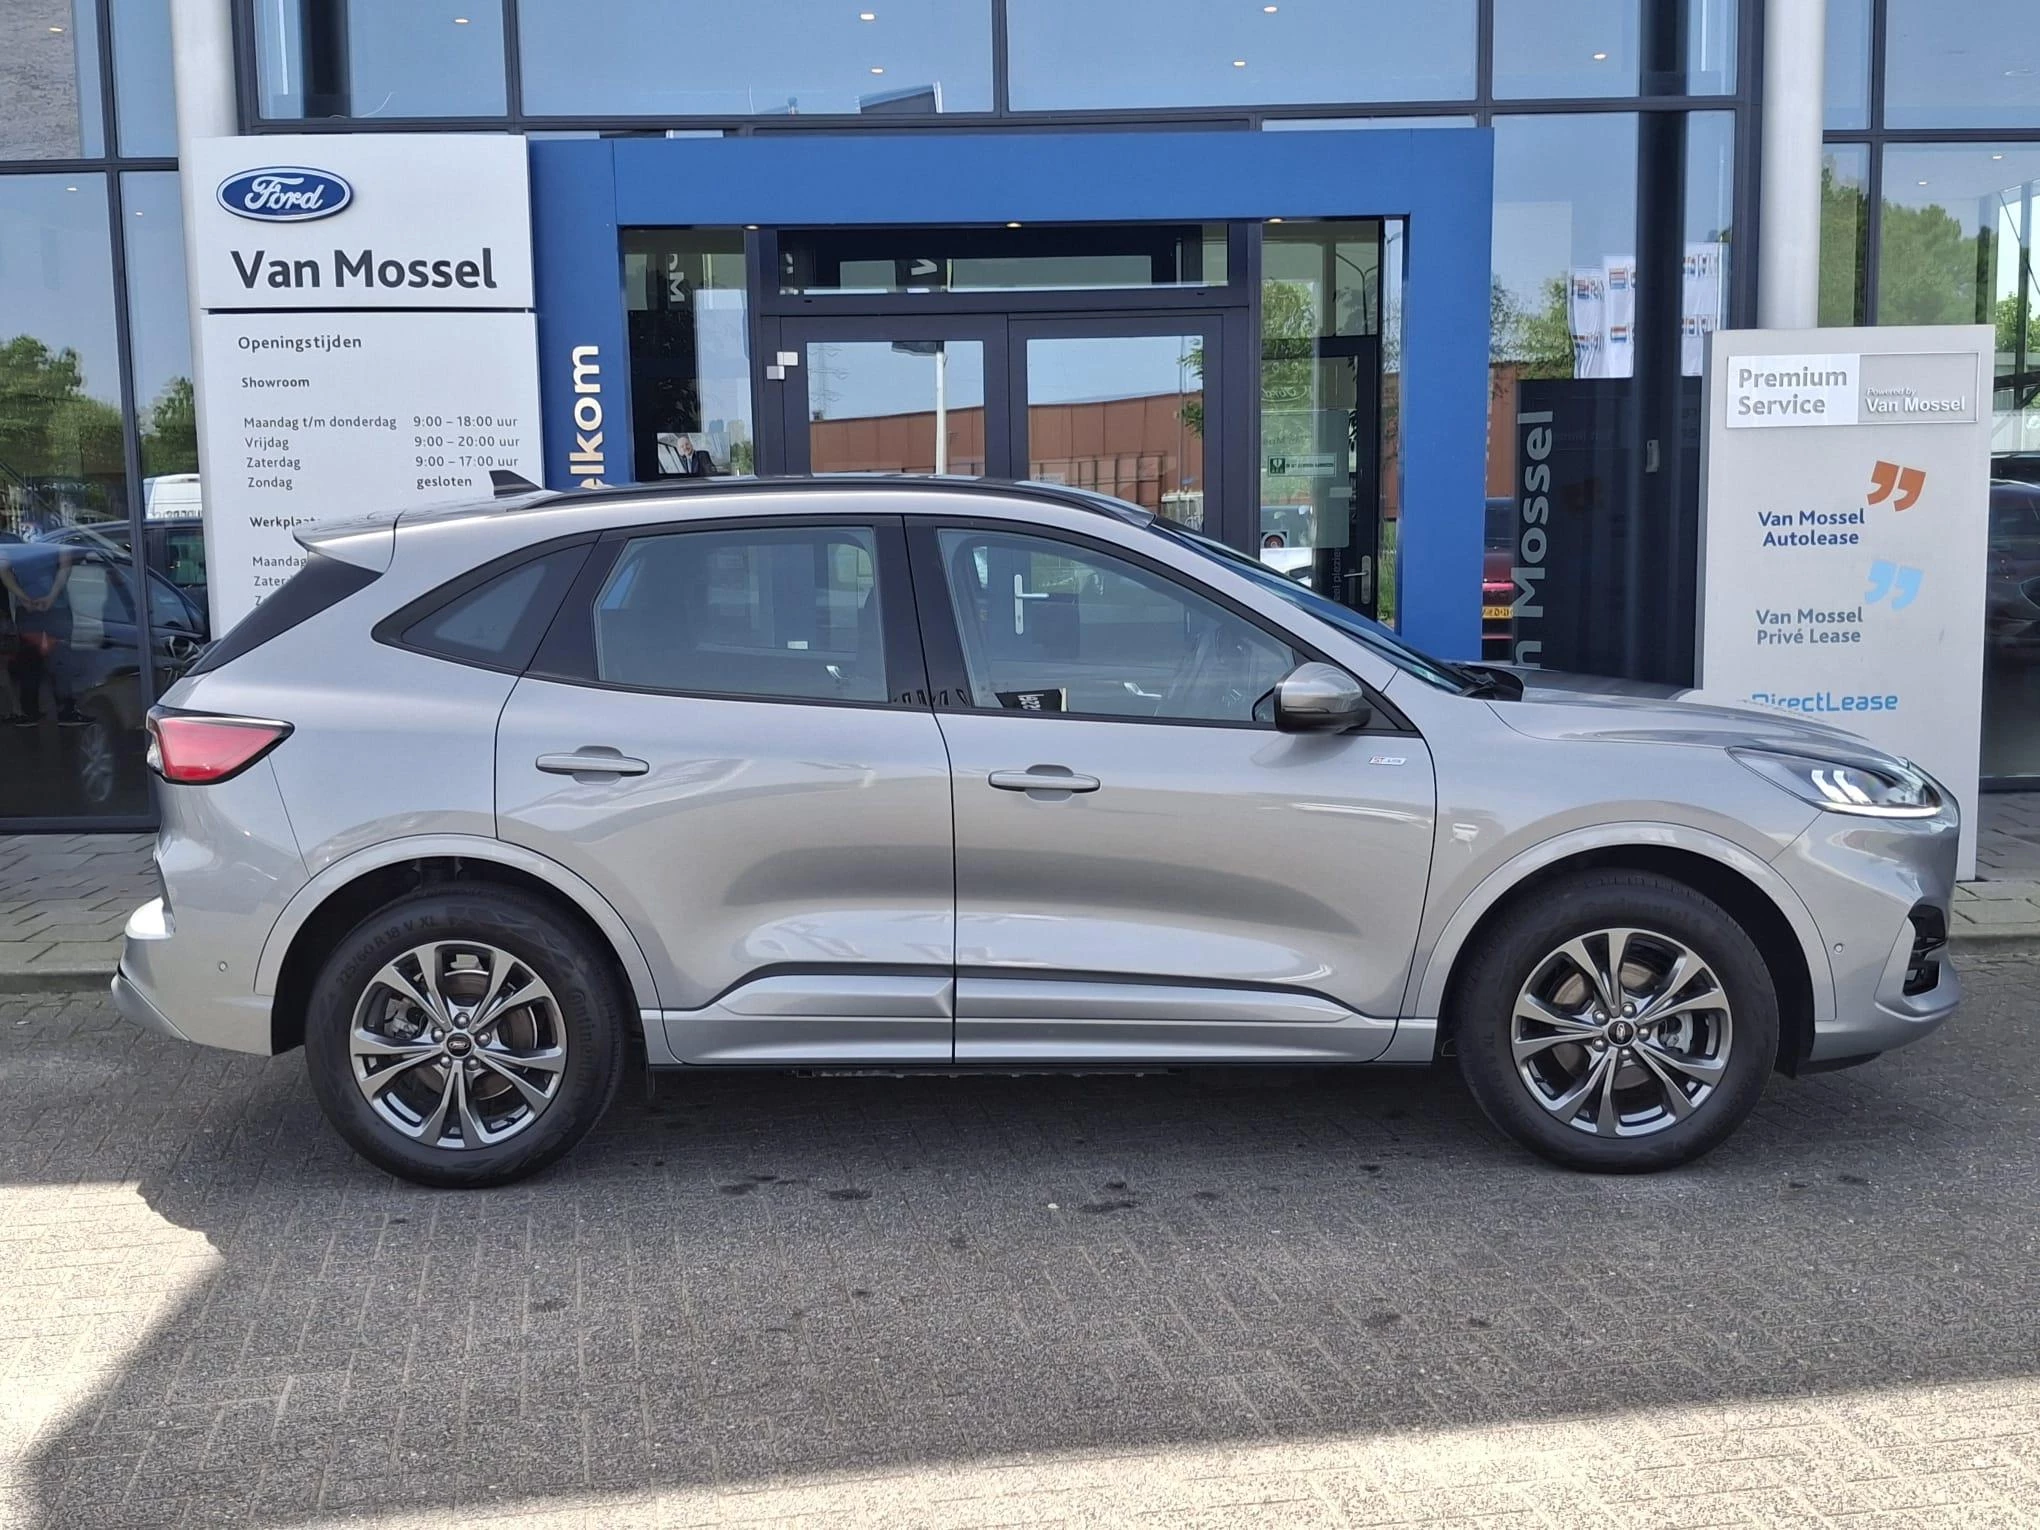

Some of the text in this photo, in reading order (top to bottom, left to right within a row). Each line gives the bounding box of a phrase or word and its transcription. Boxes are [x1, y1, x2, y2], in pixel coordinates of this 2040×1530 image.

[244, 176, 323, 210] Ford
[231, 248, 497, 288] Van Mossel
[239, 335, 361, 353] Openingstijden
[242, 377, 309, 388] Showroom
[1738, 367, 1847, 388] Premium
[1867, 387, 1917, 397] Powered by
[1738, 396, 1825, 415] Service
[1866, 396, 1965, 413] Van Mossel
[244, 416, 396, 430] Maandag t/m donderdag
[414, 416, 442, 427] 9:00
[457, 416, 492, 426] 18:00
[245, 437, 289, 451] Vrijdag
[415, 436, 443, 447] 9:00
[458, 436, 494, 447] 20:00
[247, 456, 301, 470] Zaterdag
[416, 456, 444, 467] 9:00
[459, 456, 493, 466] 17:00
[248, 477, 292, 490] Zondag
[417, 476, 471, 489] gesloten
[1510, 411, 1553, 618] Mossel
[1758, 508, 1864, 526] Van Mossel
[1763, 530, 1859, 546] Autolease
[1756, 606, 1863, 624] Van Mossel
[1758, 628, 1860, 644] Privé Lease
